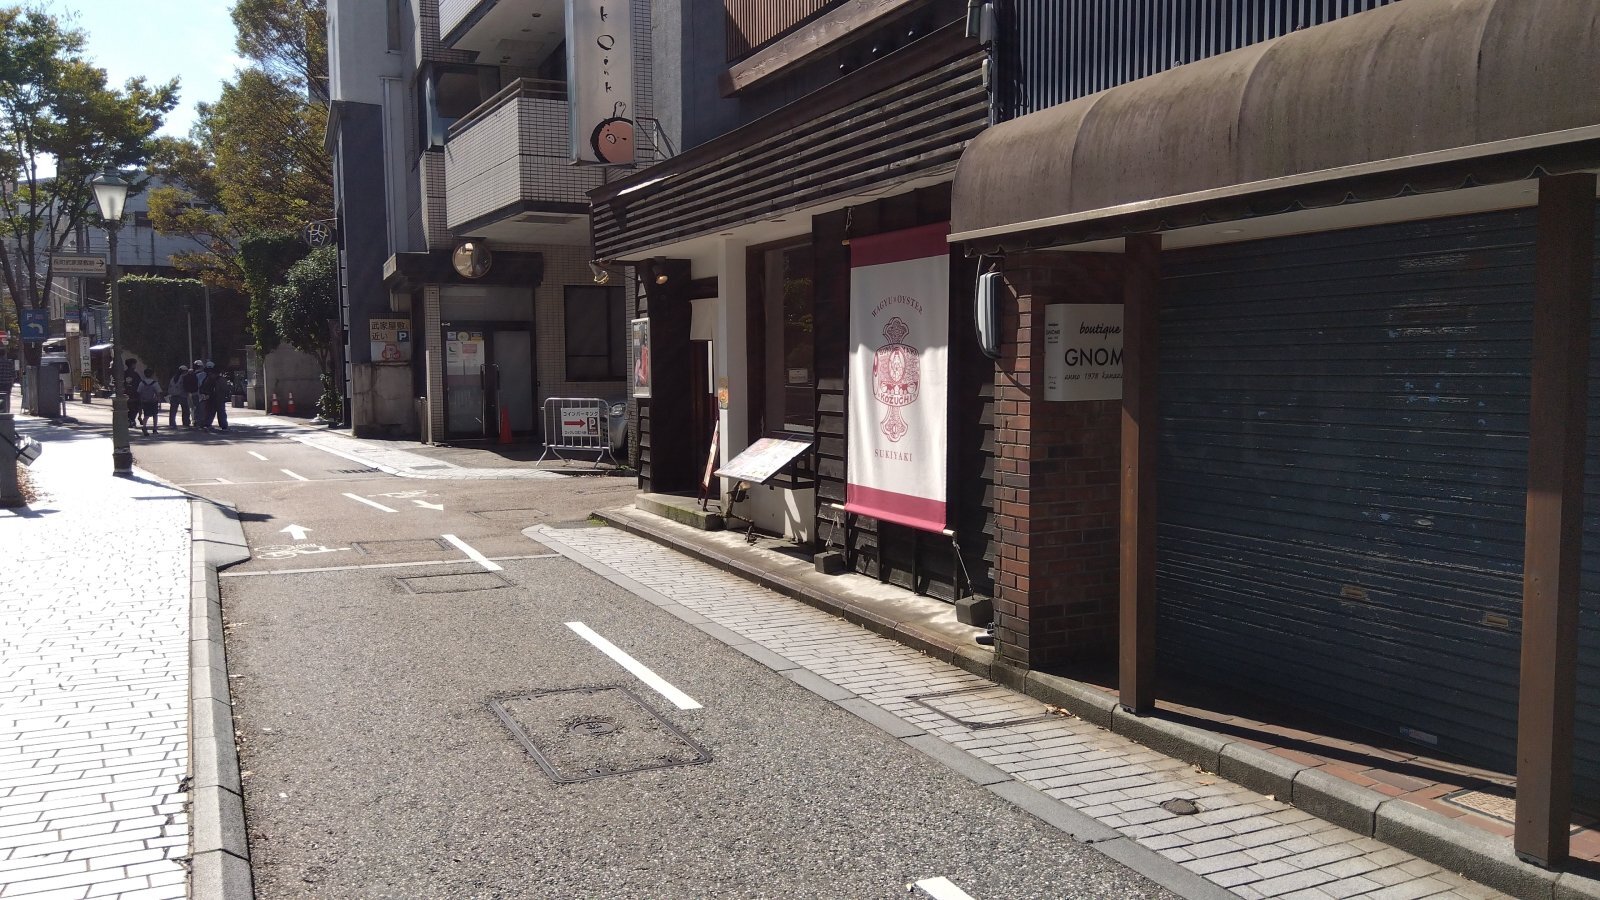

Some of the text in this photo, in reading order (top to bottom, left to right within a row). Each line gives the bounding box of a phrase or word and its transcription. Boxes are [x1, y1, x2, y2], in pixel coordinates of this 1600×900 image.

[26, 313, 33, 321] P
[371, 321, 405, 330] 武家屋敷
[1080, 321, 1122, 340] boutique
[371, 332, 407, 341] 近い P
[1065, 348, 1124, 367] GNOM
[589, 417, 596, 430] P
[874, 448, 913, 462] SUKIYAKI
